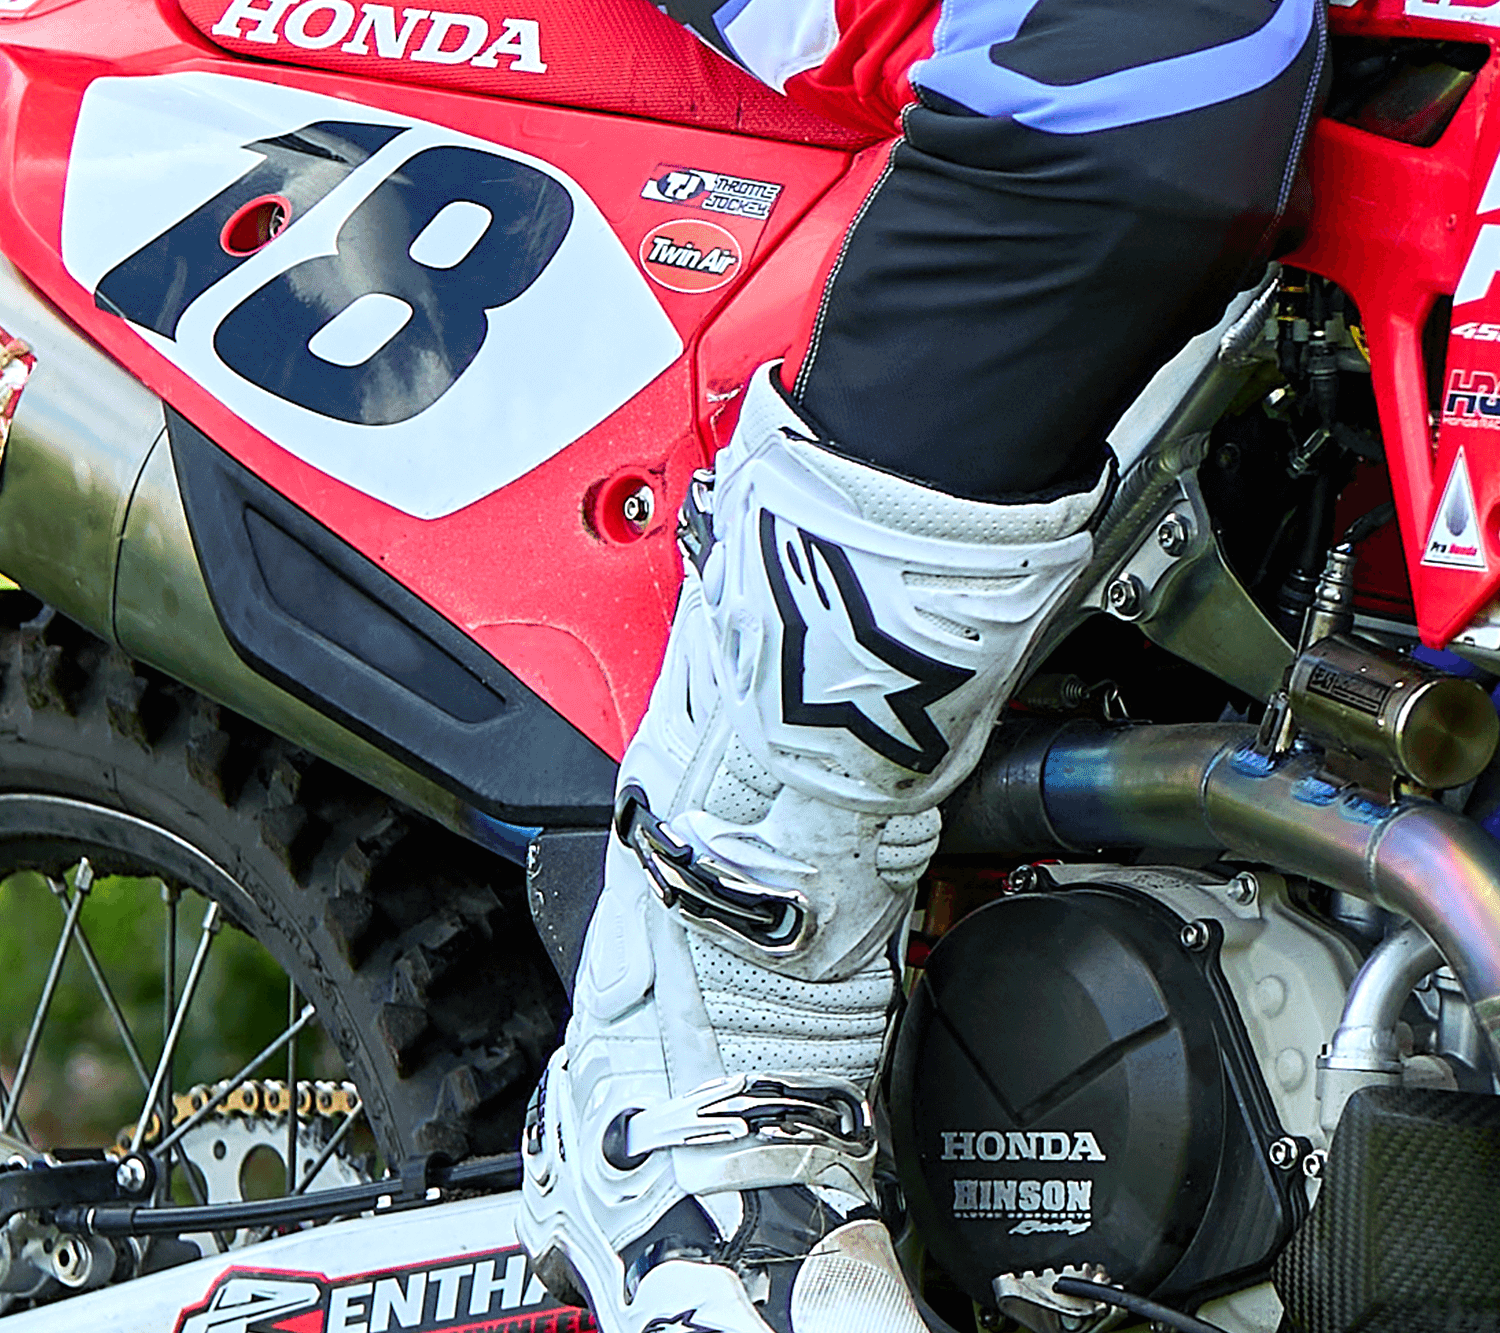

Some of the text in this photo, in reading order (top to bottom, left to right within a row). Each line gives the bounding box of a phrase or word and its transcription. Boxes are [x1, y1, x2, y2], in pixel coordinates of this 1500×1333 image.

[94, 120, 576, 427] 18
[648, 235, 738, 276] Twin Air
[940, 1130, 1107, 1162] HONDA
[953, 1179, 1093, 1212] HINSON
